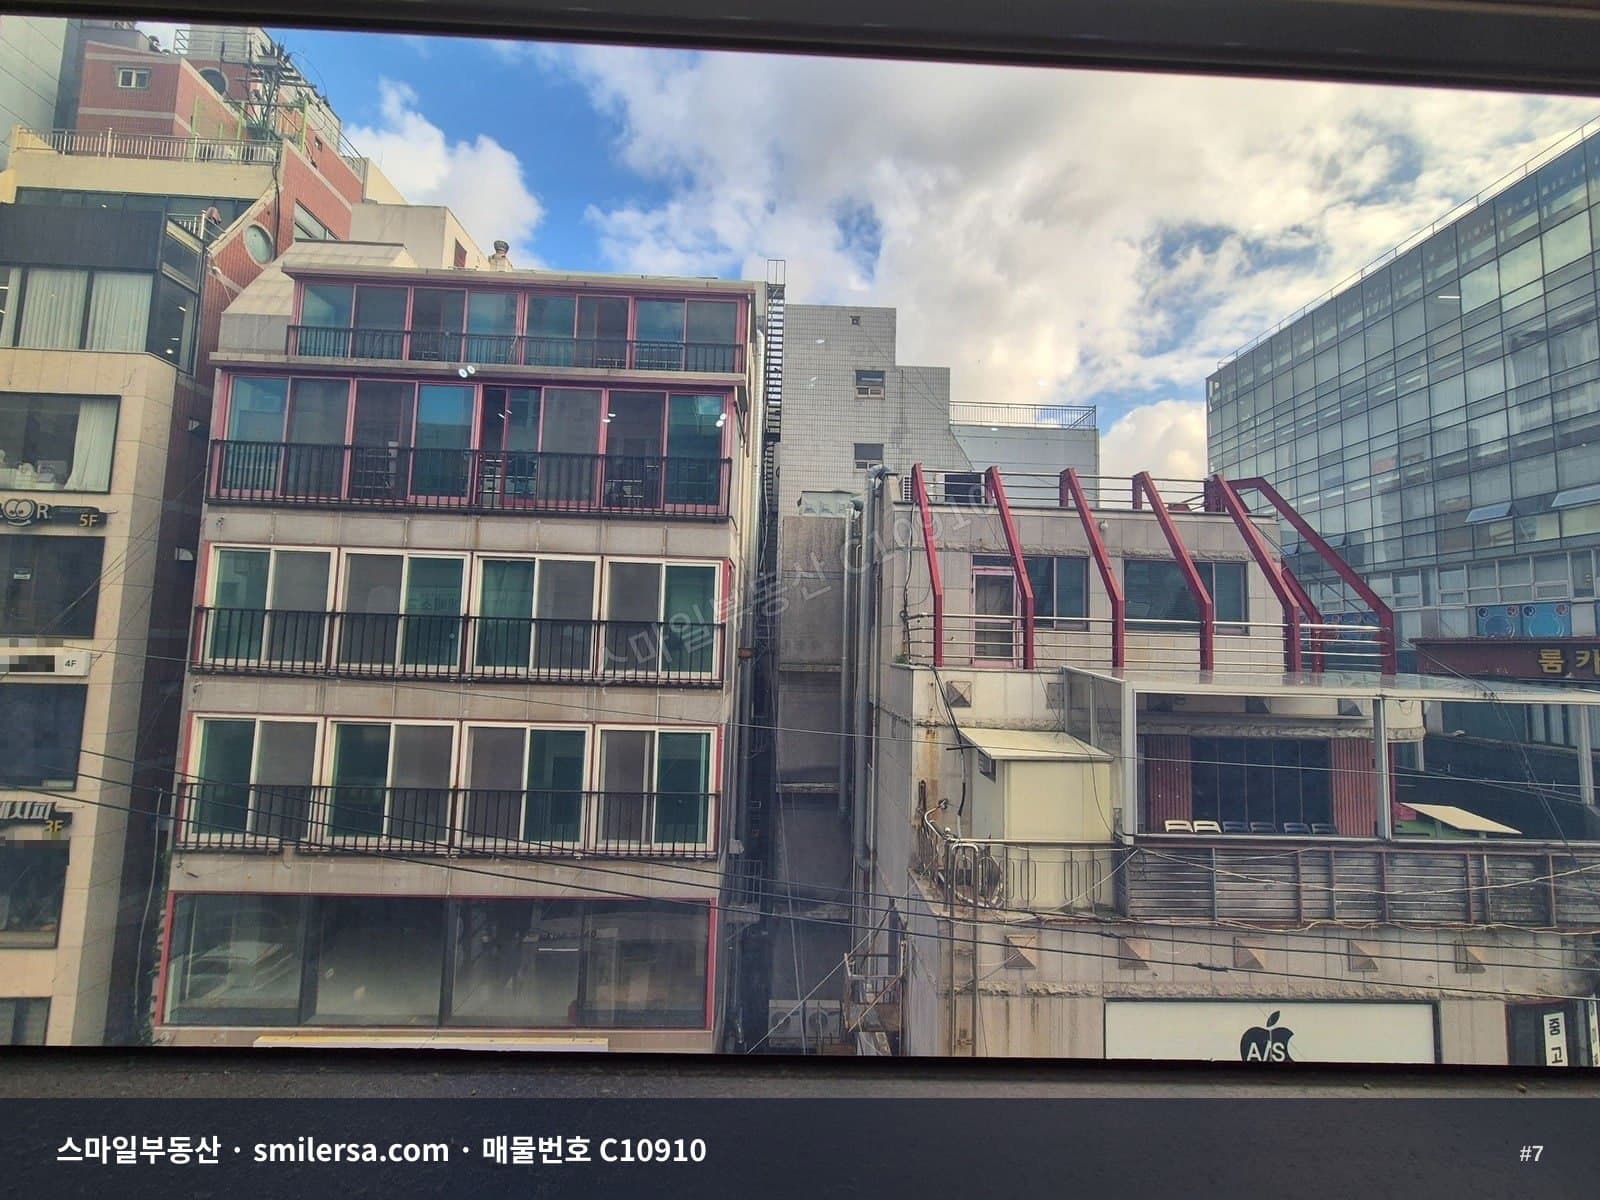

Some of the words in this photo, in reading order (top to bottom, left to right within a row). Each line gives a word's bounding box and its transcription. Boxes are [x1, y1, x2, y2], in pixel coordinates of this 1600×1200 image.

[80, 514, 98, 527] 5F
[64, 659, 77, 668] 4F
[45, 820, 65, 832] 3F
[1246, 1041, 1286, 1062] A/S
